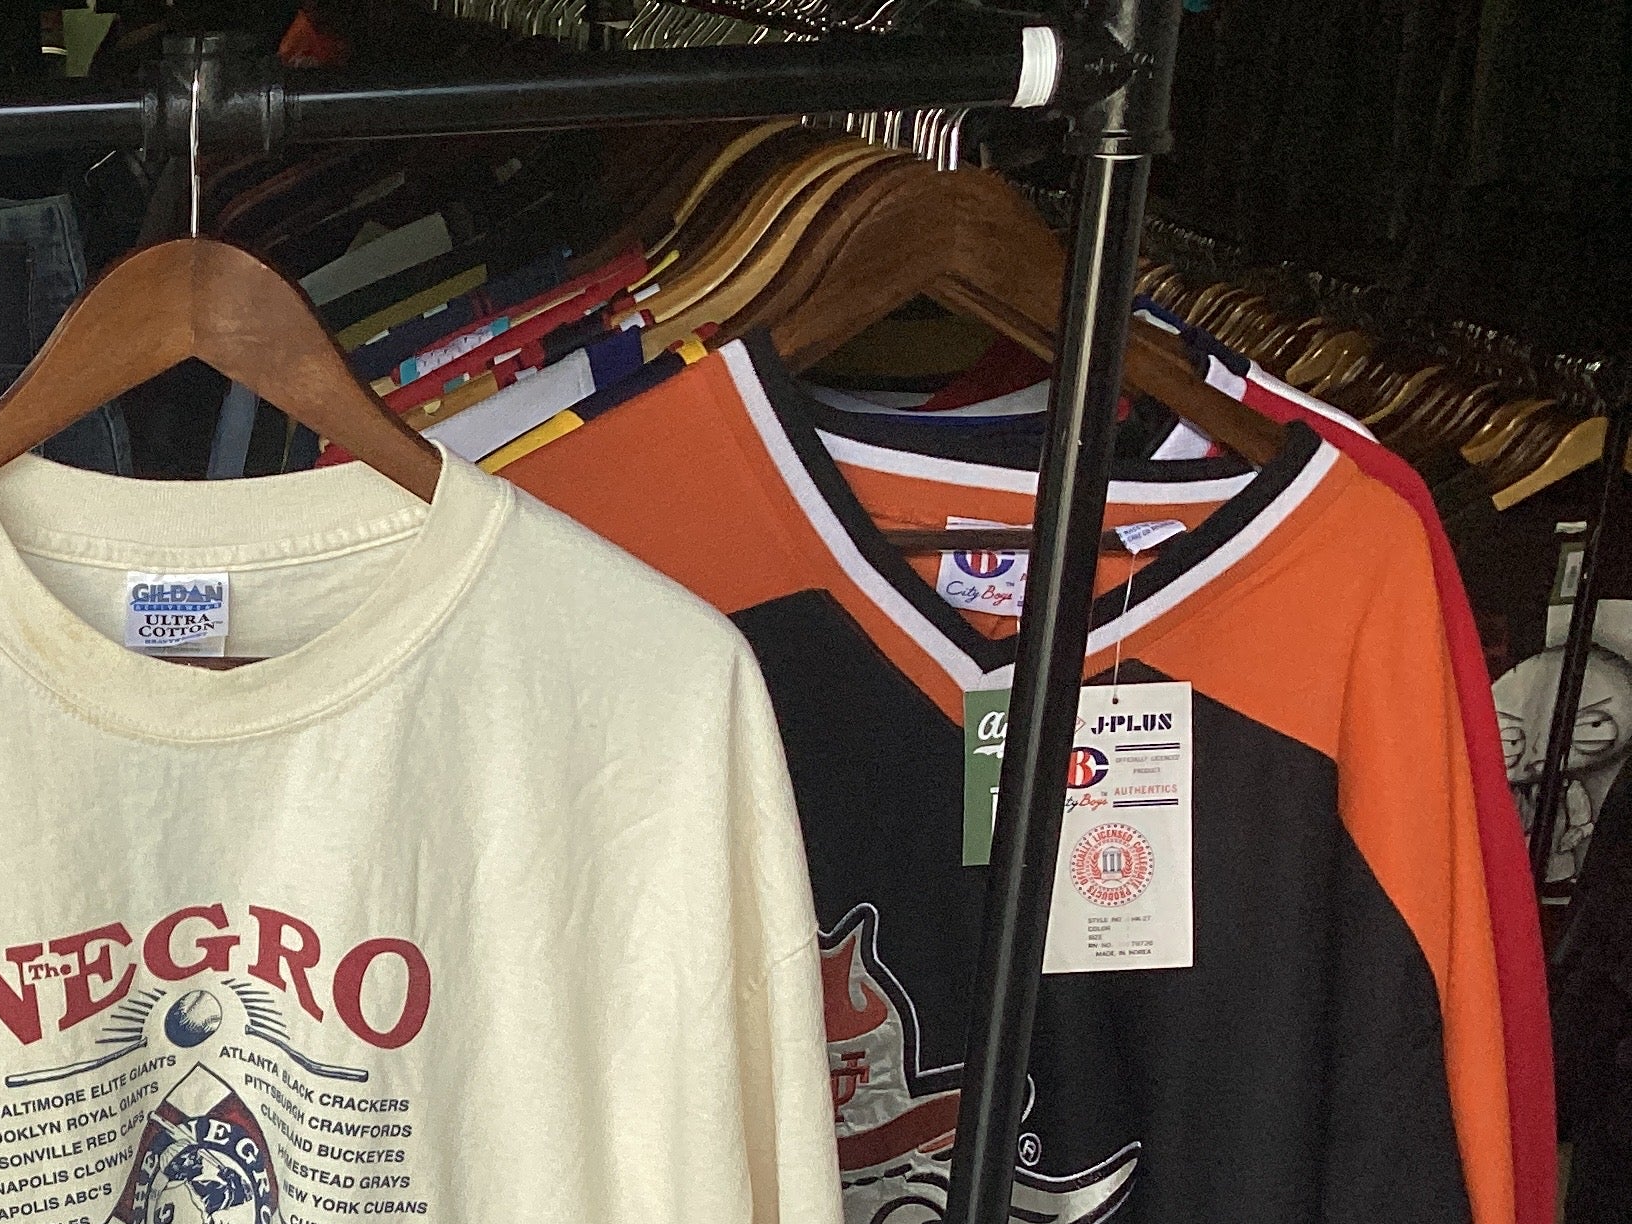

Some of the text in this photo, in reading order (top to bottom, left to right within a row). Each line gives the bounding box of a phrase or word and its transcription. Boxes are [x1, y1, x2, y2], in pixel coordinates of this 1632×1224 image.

[132, 584, 223, 603] GILDAN
[946, 581, 979, 600] City
[981, 585, 1013, 606] Boys
[138, 621, 215, 637] COTTON
[144, 614, 210, 626] ULTRA
[1114, 784, 1177, 796] AUTHENTICS
[27, 961, 73, 981] The
[91, 1074, 127, 1099] ELITE
[129, 1055, 176, 1082] GIANTS
[219, 1045, 410, 1113] ATLANTA BLACK CRACKERS
[66, 1105, 117, 1131] ROYAL
[119, 1082, 159, 1111] GIANTS
[244, 1074, 413, 1139] PITTSBURGH CRAWFORDS
[87, 1129, 117, 1151] RED
[120, 1110, 145, 1138] CAPS
[260, 1103, 405, 1164] CLEVELAND BUCKEYES
[73, 1145, 134, 1180] CLOWNS
[64, 1183, 112, 1208] ABC'S
[282, 1179, 428, 1214] NEW YORK CUBANS
[359, 1176, 410, 1189] GRAYS
